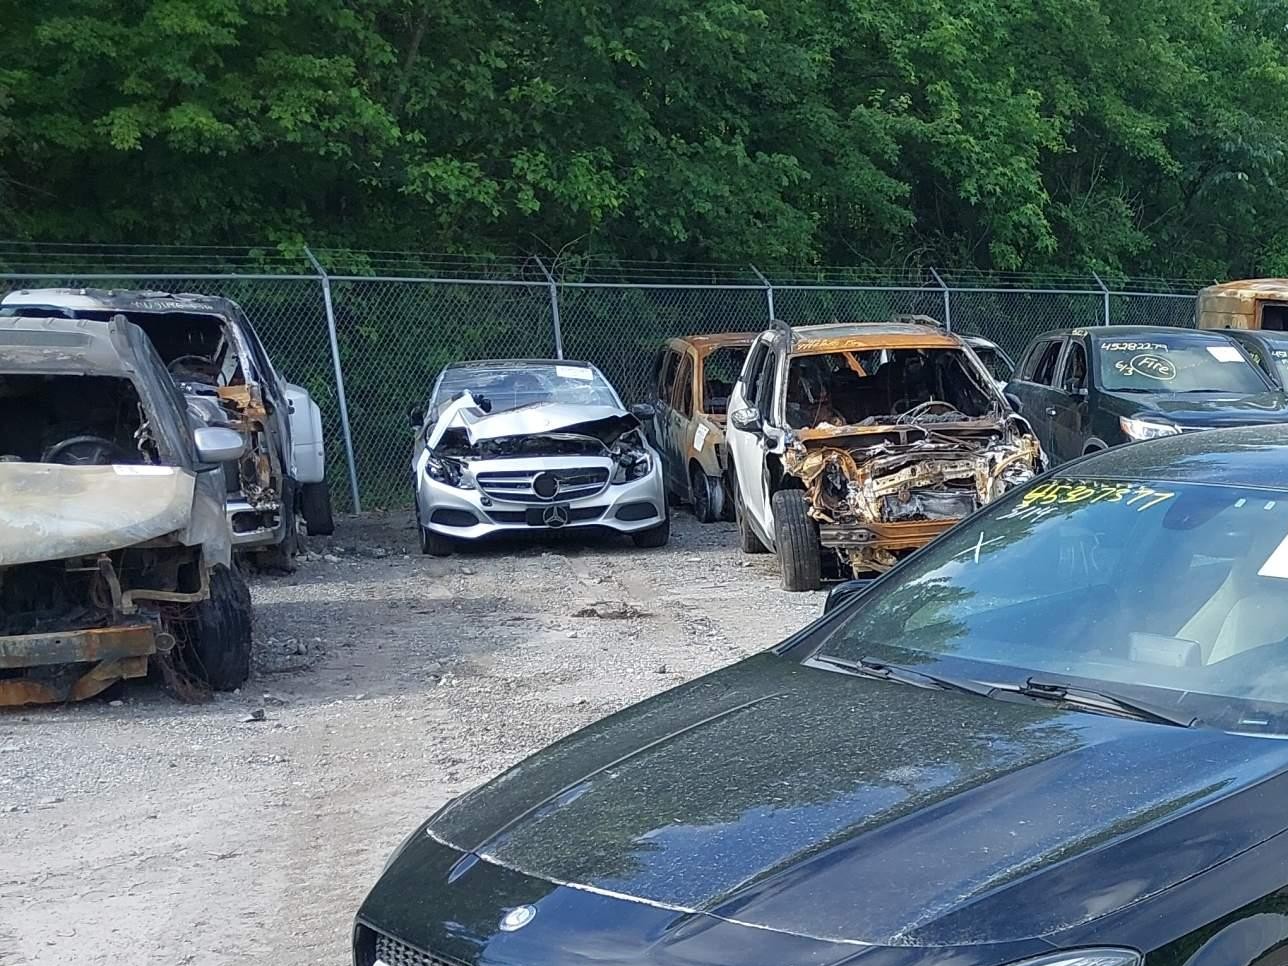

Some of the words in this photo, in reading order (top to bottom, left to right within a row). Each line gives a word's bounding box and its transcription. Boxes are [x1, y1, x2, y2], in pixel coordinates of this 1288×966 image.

[1115, 360, 1134, 376] 6/3
[1137, 357, 1170, 375] Fire
[1019, 484, 1176, 513] 45307377
